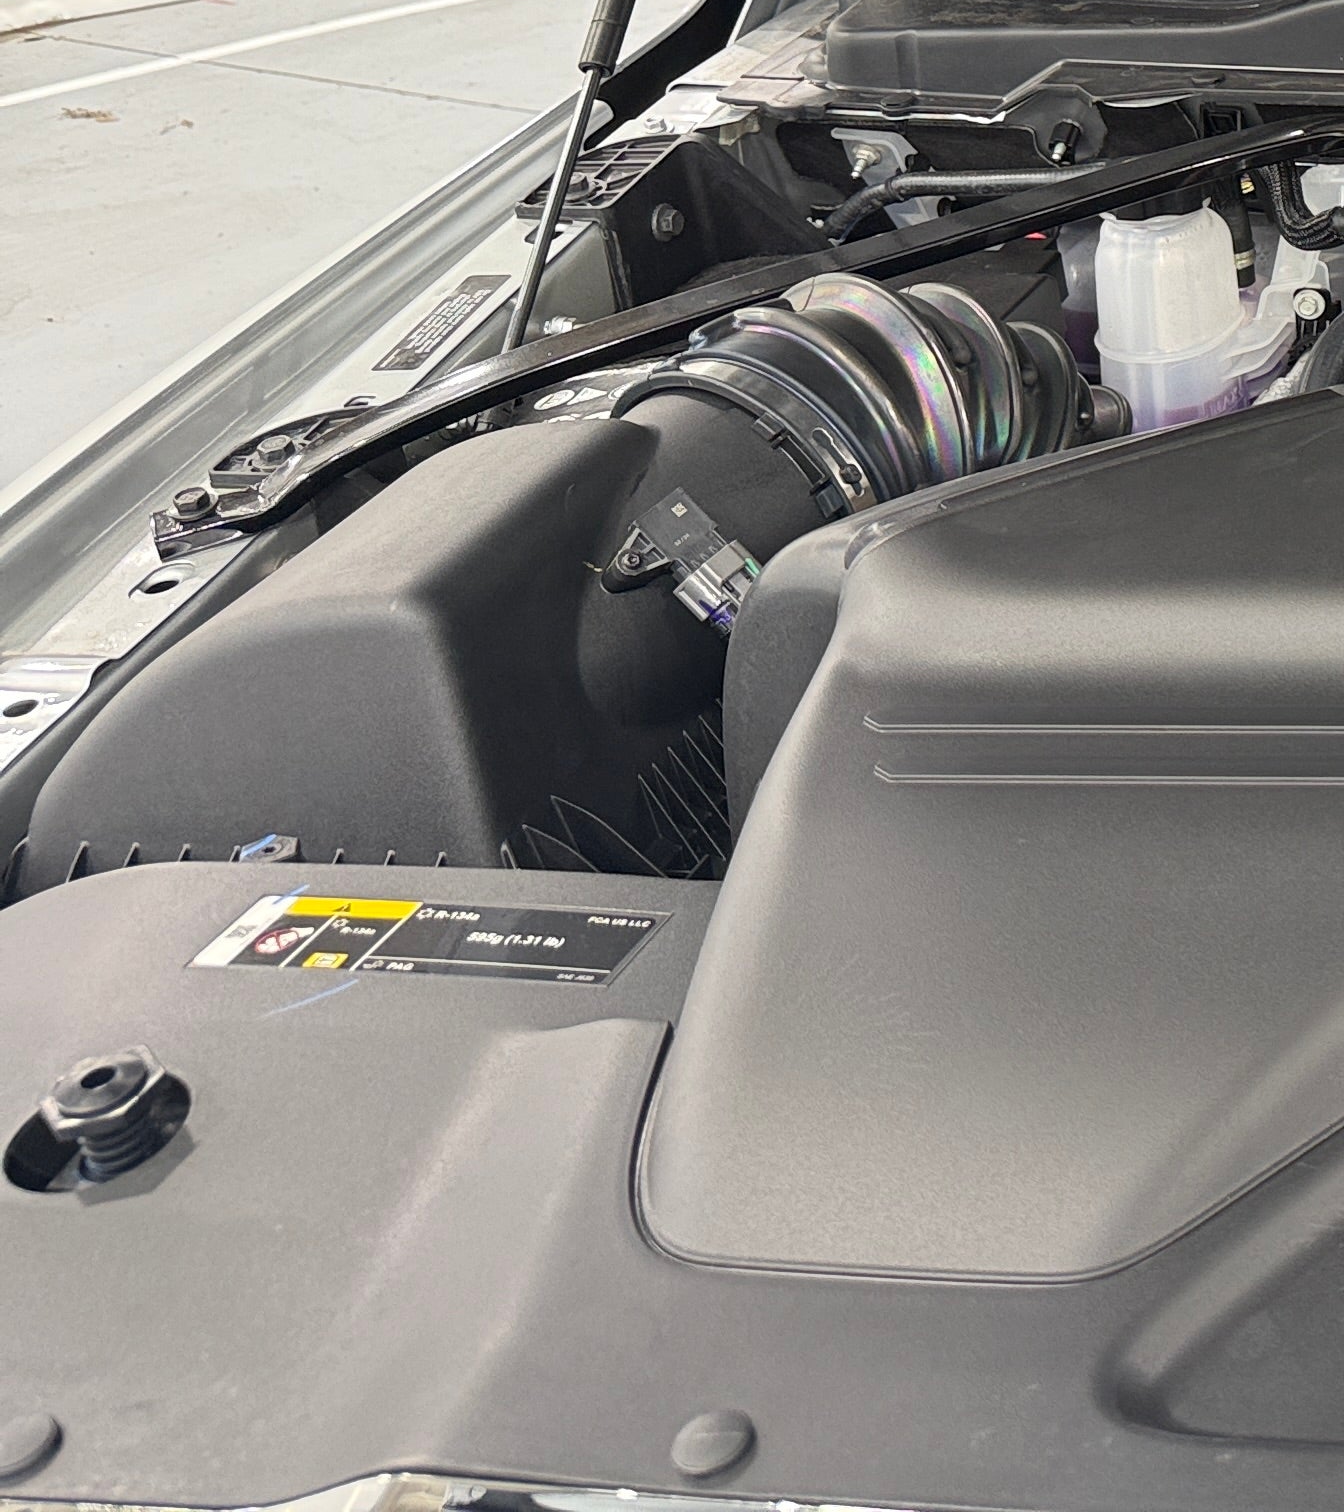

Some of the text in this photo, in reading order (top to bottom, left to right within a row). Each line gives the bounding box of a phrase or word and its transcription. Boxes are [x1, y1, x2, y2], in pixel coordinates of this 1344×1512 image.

[434, 908, 481, 921] R-134a
[587, 915, 652, 928] FCA US LLC
